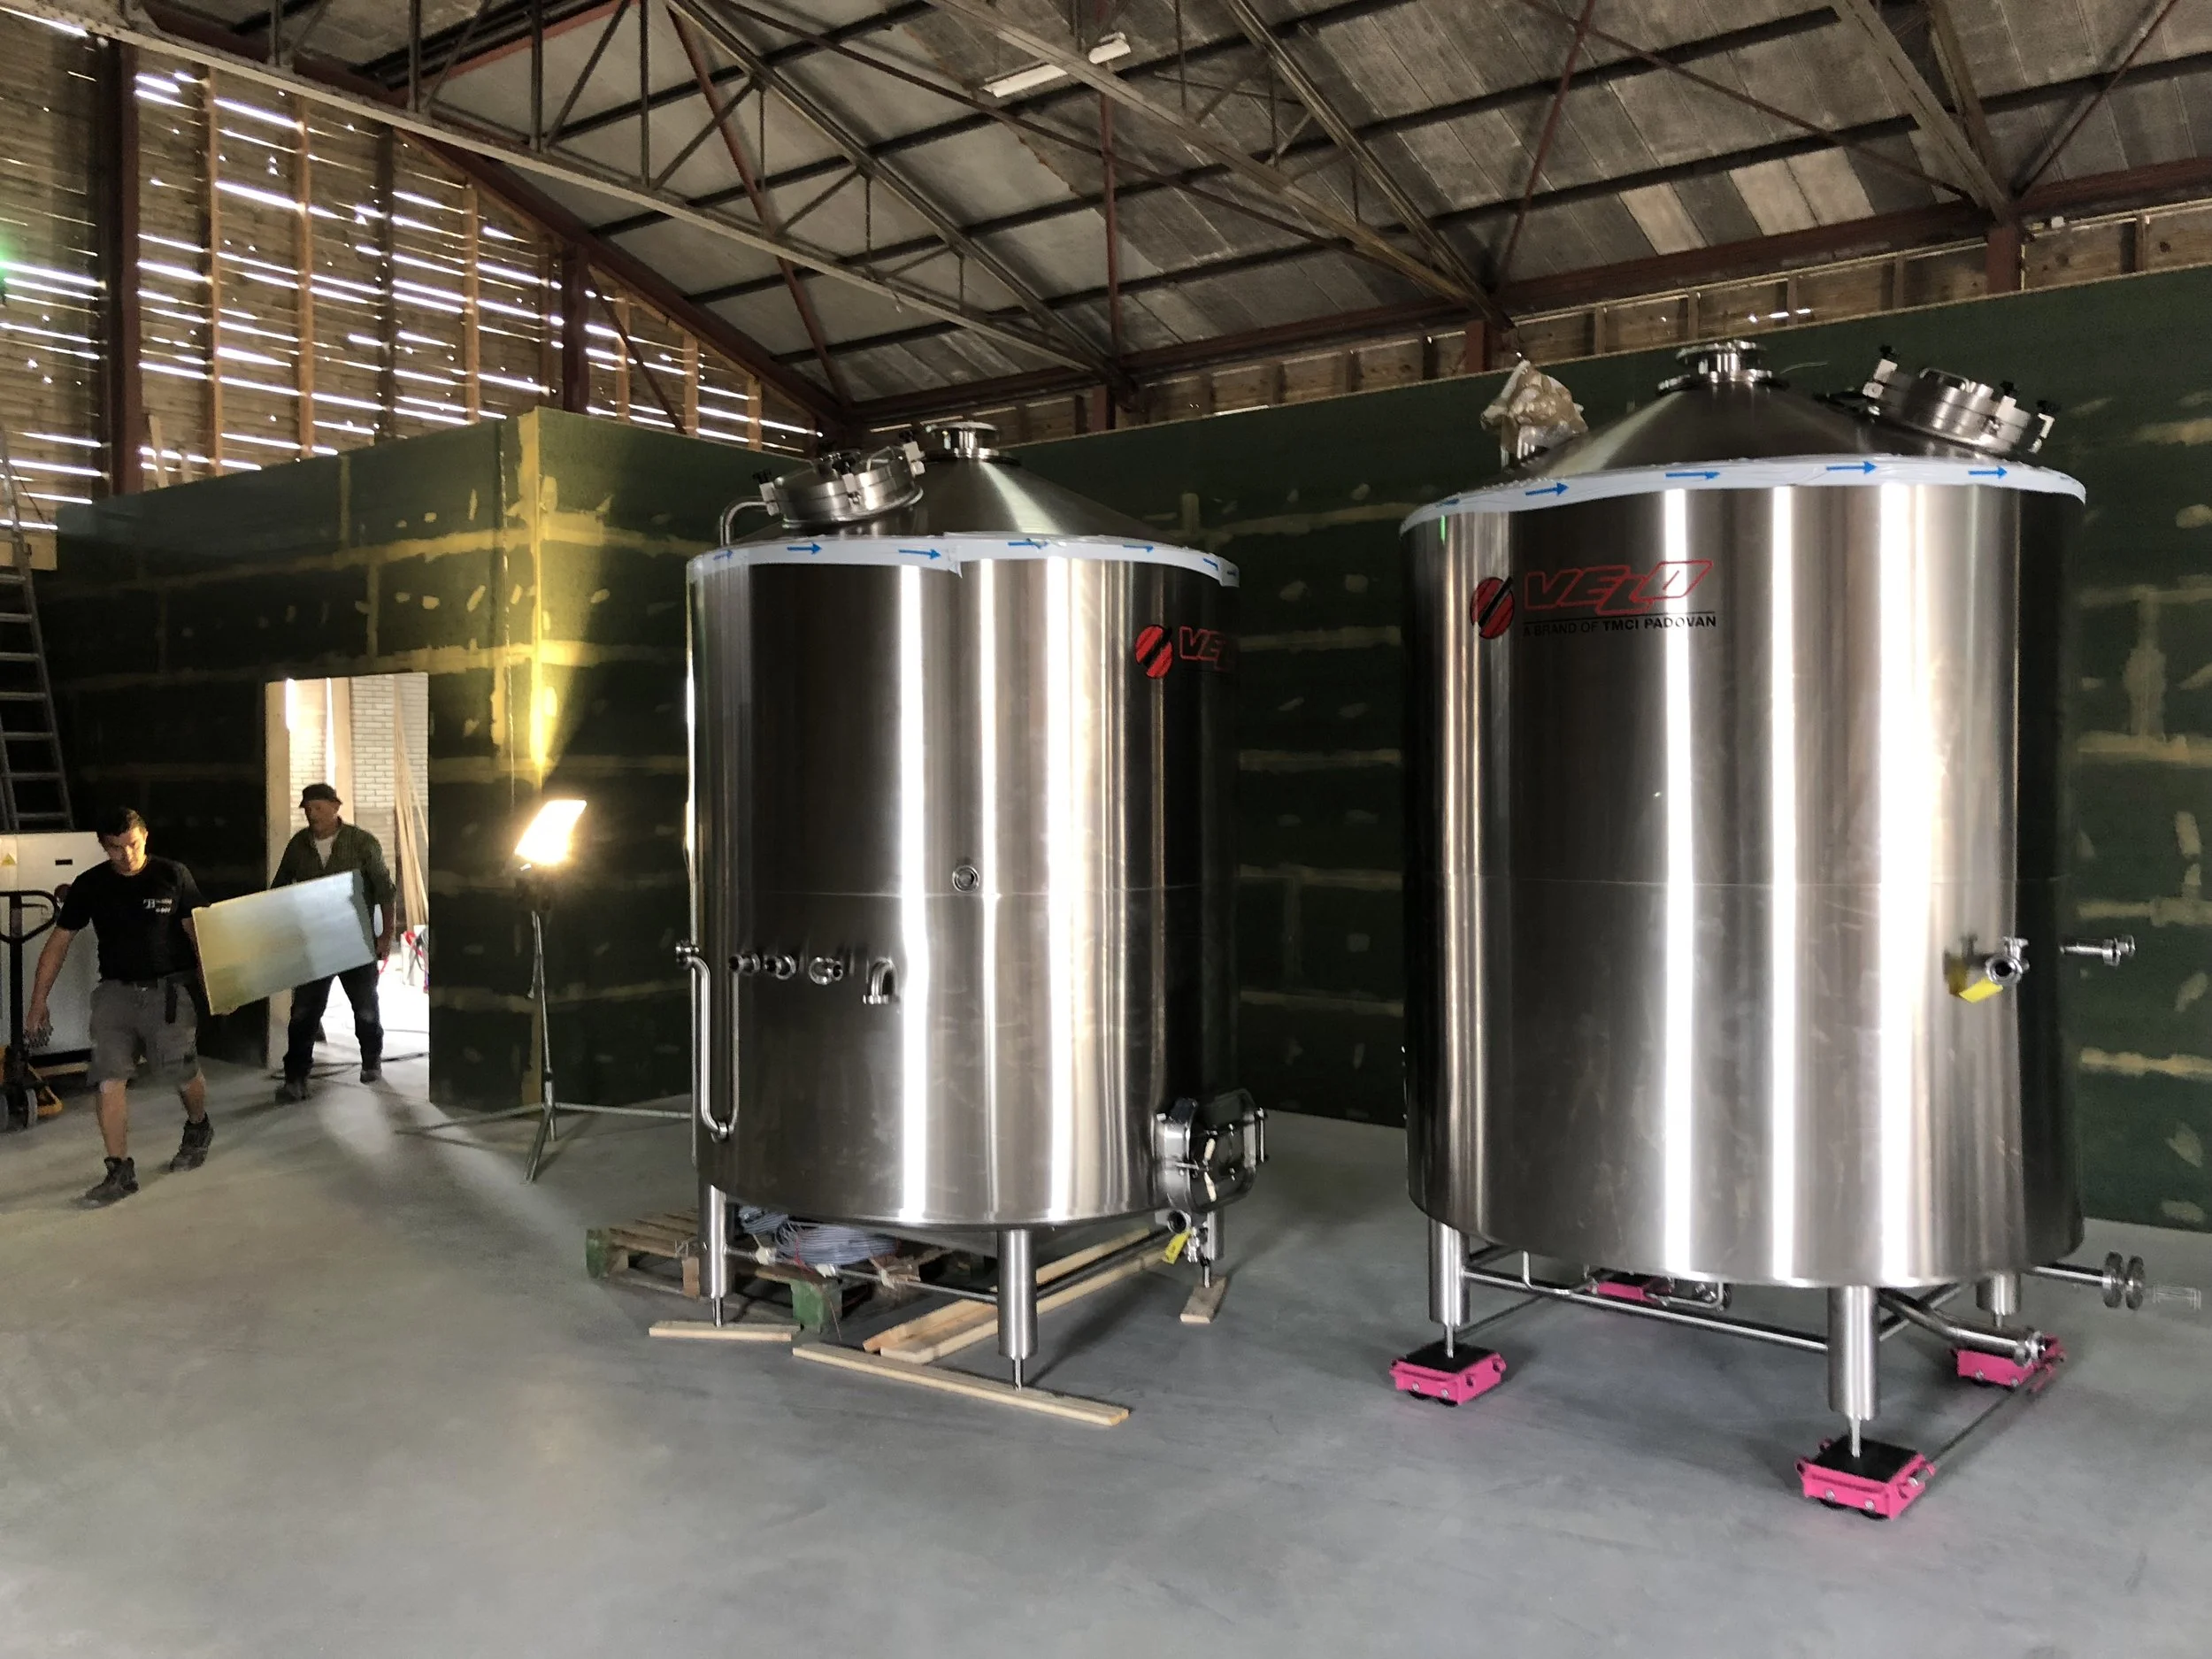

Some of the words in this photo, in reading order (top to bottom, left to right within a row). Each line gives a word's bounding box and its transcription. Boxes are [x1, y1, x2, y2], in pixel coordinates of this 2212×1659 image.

[1524, 559, 1714, 616] VELO
[1533, 622, 1577, 637] BRAND
[1580, 621, 1599, 634] OF
[1602, 619, 1639, 632] TMCI
[1644, 616, 1717, 630] PADOVAN
